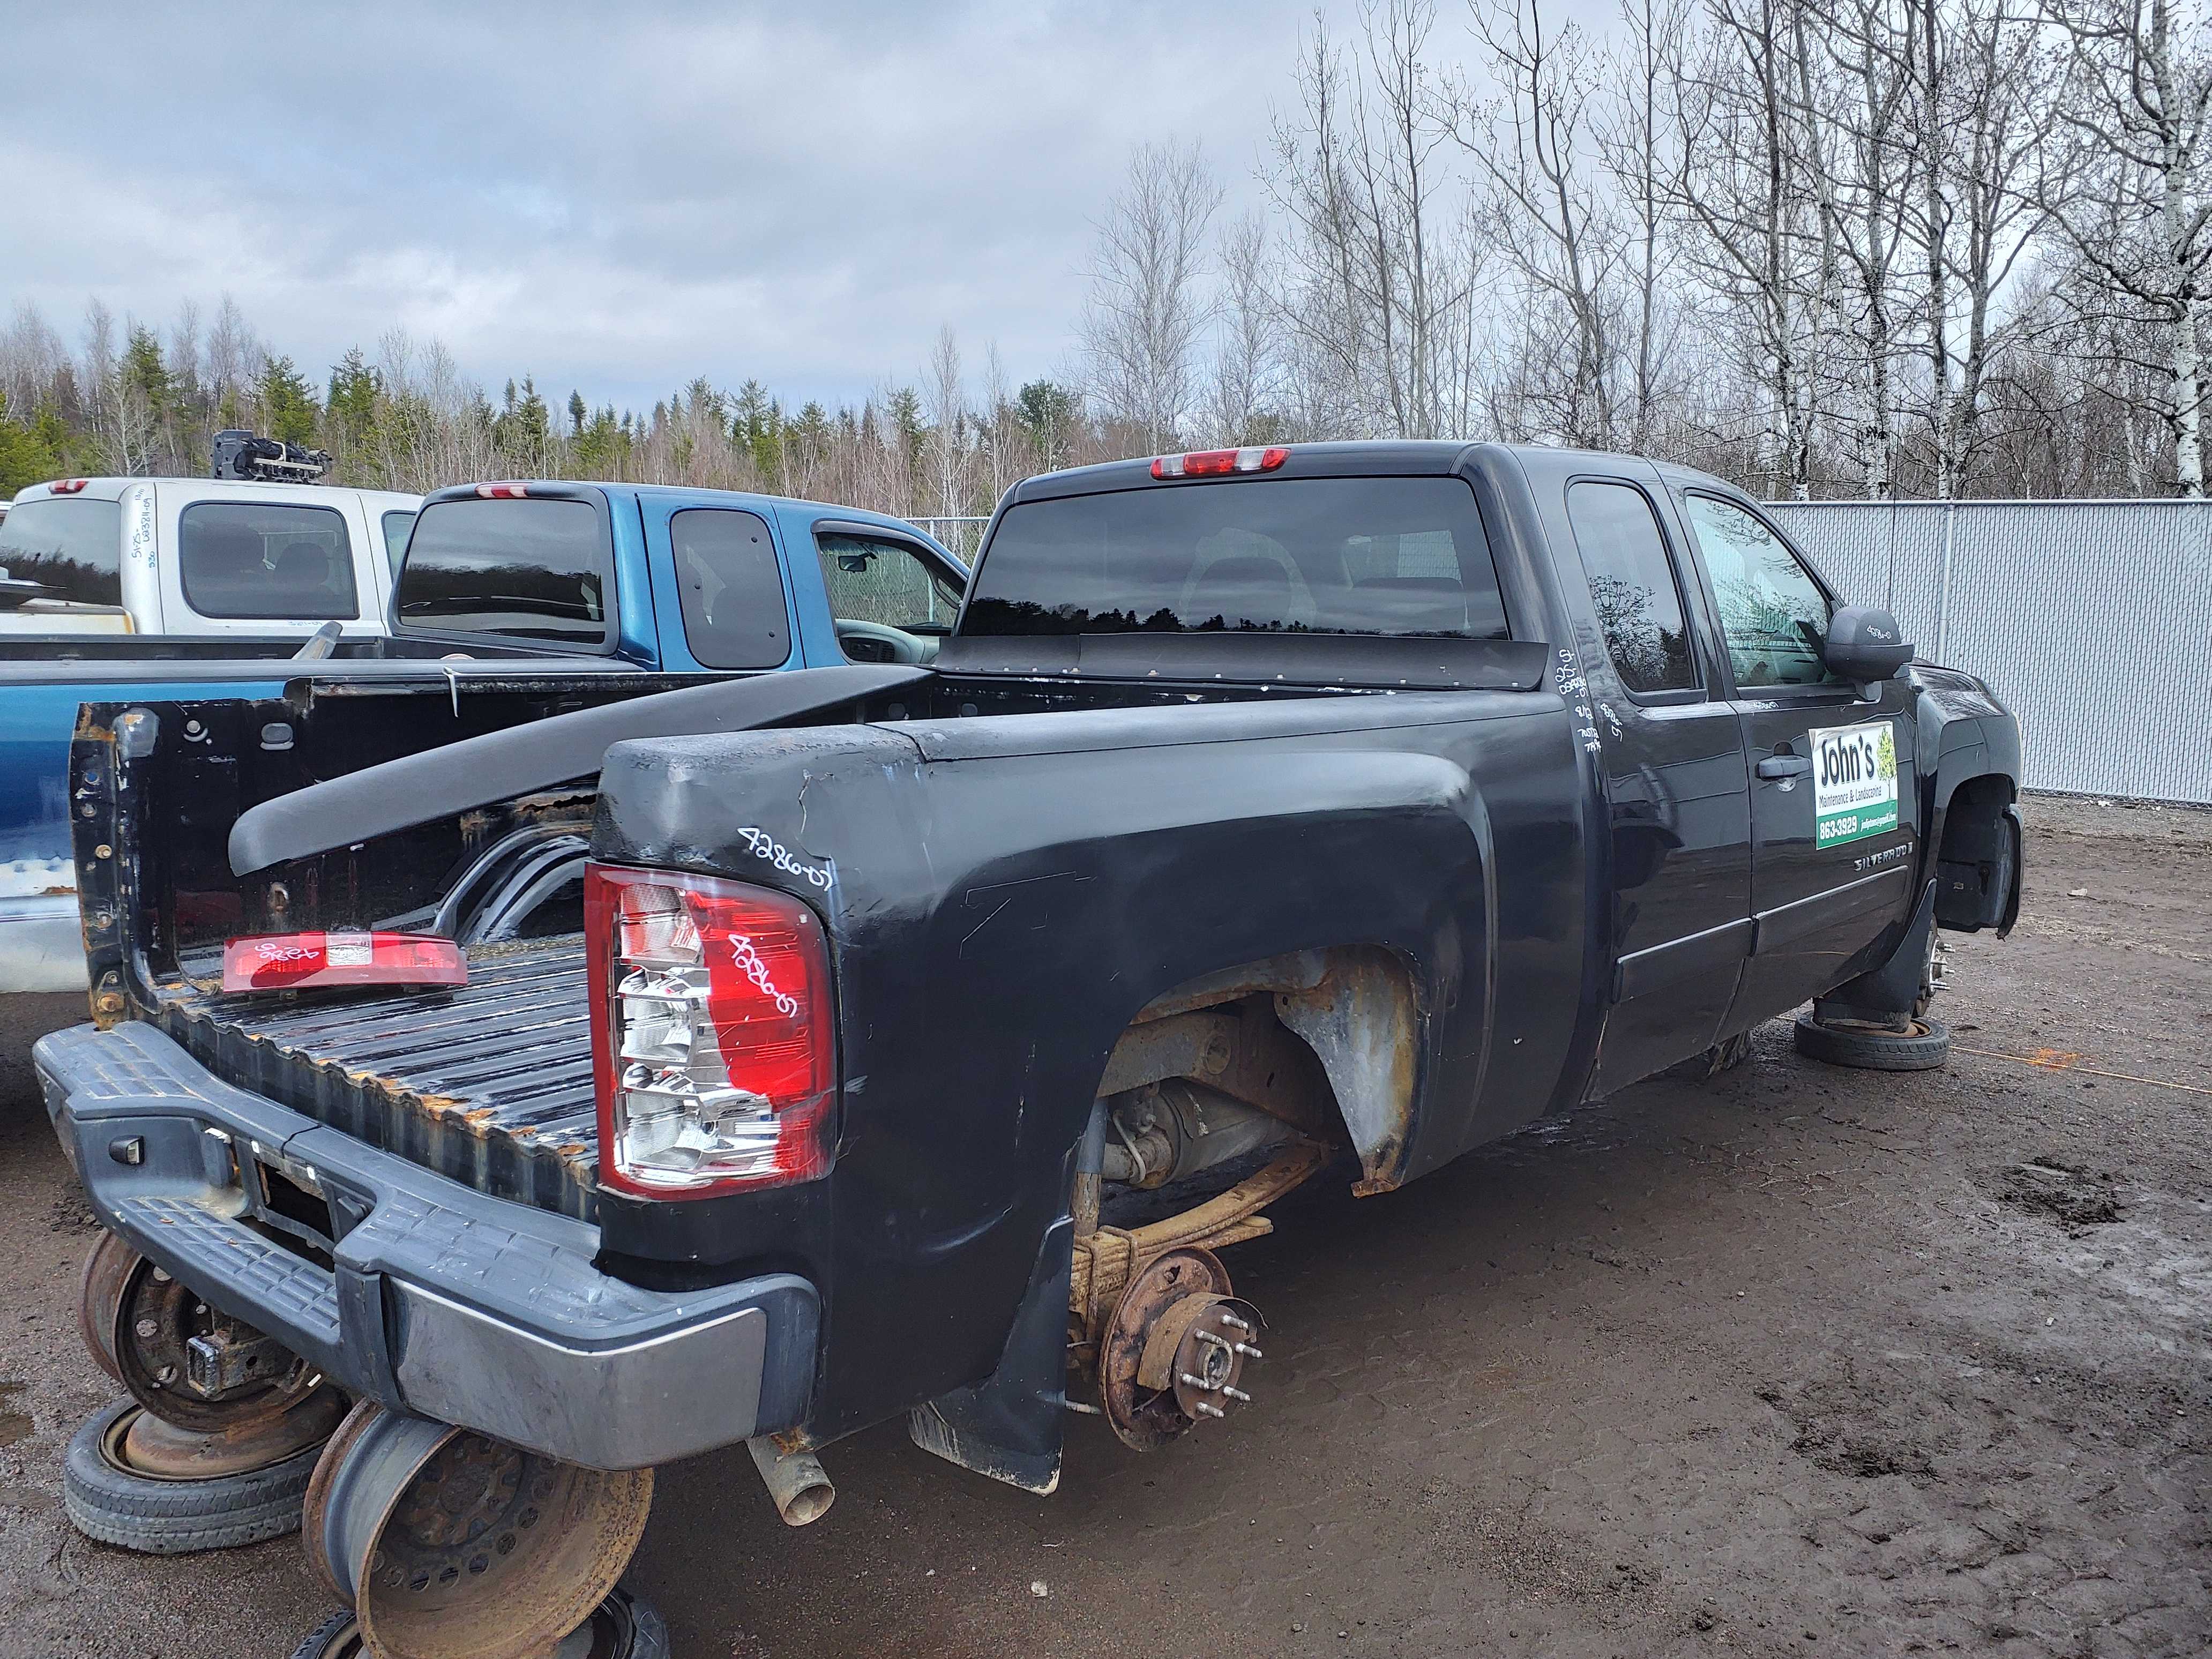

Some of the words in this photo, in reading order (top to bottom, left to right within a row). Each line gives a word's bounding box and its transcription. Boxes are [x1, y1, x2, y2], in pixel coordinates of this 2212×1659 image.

[1821, 733, 1875, 788] John's
[1819, 792, 1848, 808] Maintenance
[1850, 789, 1854, 803] &
[1856, 785, 1882, 801] Landscaping
[1820, 815, 1858, 840] 863-3929
[1854, 843, 1908, 872] SILVERADO
